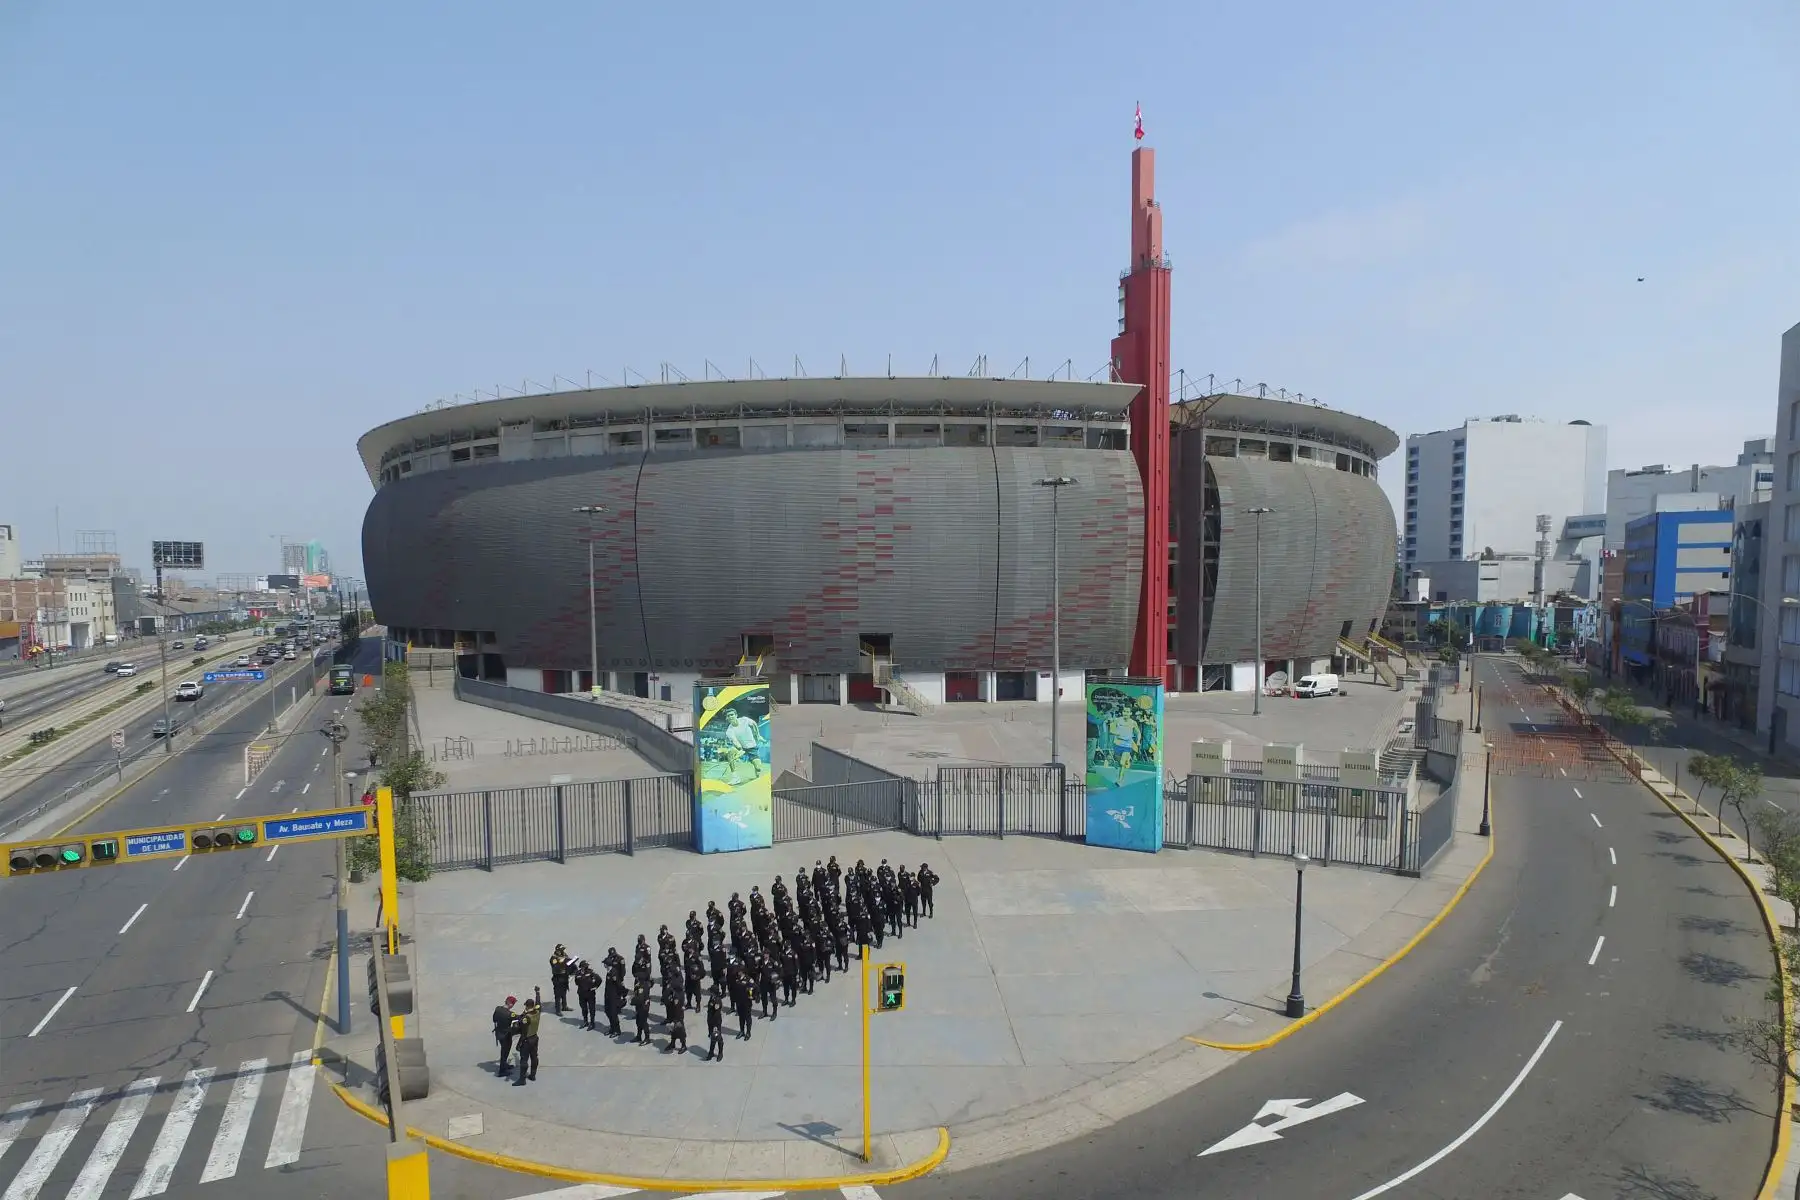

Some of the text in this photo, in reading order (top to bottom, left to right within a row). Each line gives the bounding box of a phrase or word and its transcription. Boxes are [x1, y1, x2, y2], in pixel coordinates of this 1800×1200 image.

[279, 825, 290, 833] Av.
[292, 822, 322, 831] Bausate
[334, 819, 353, 827] Meza
[128, 832, 184, 845] MUNICIPALIDAD
[154, 843, 171, 851] LIMA
